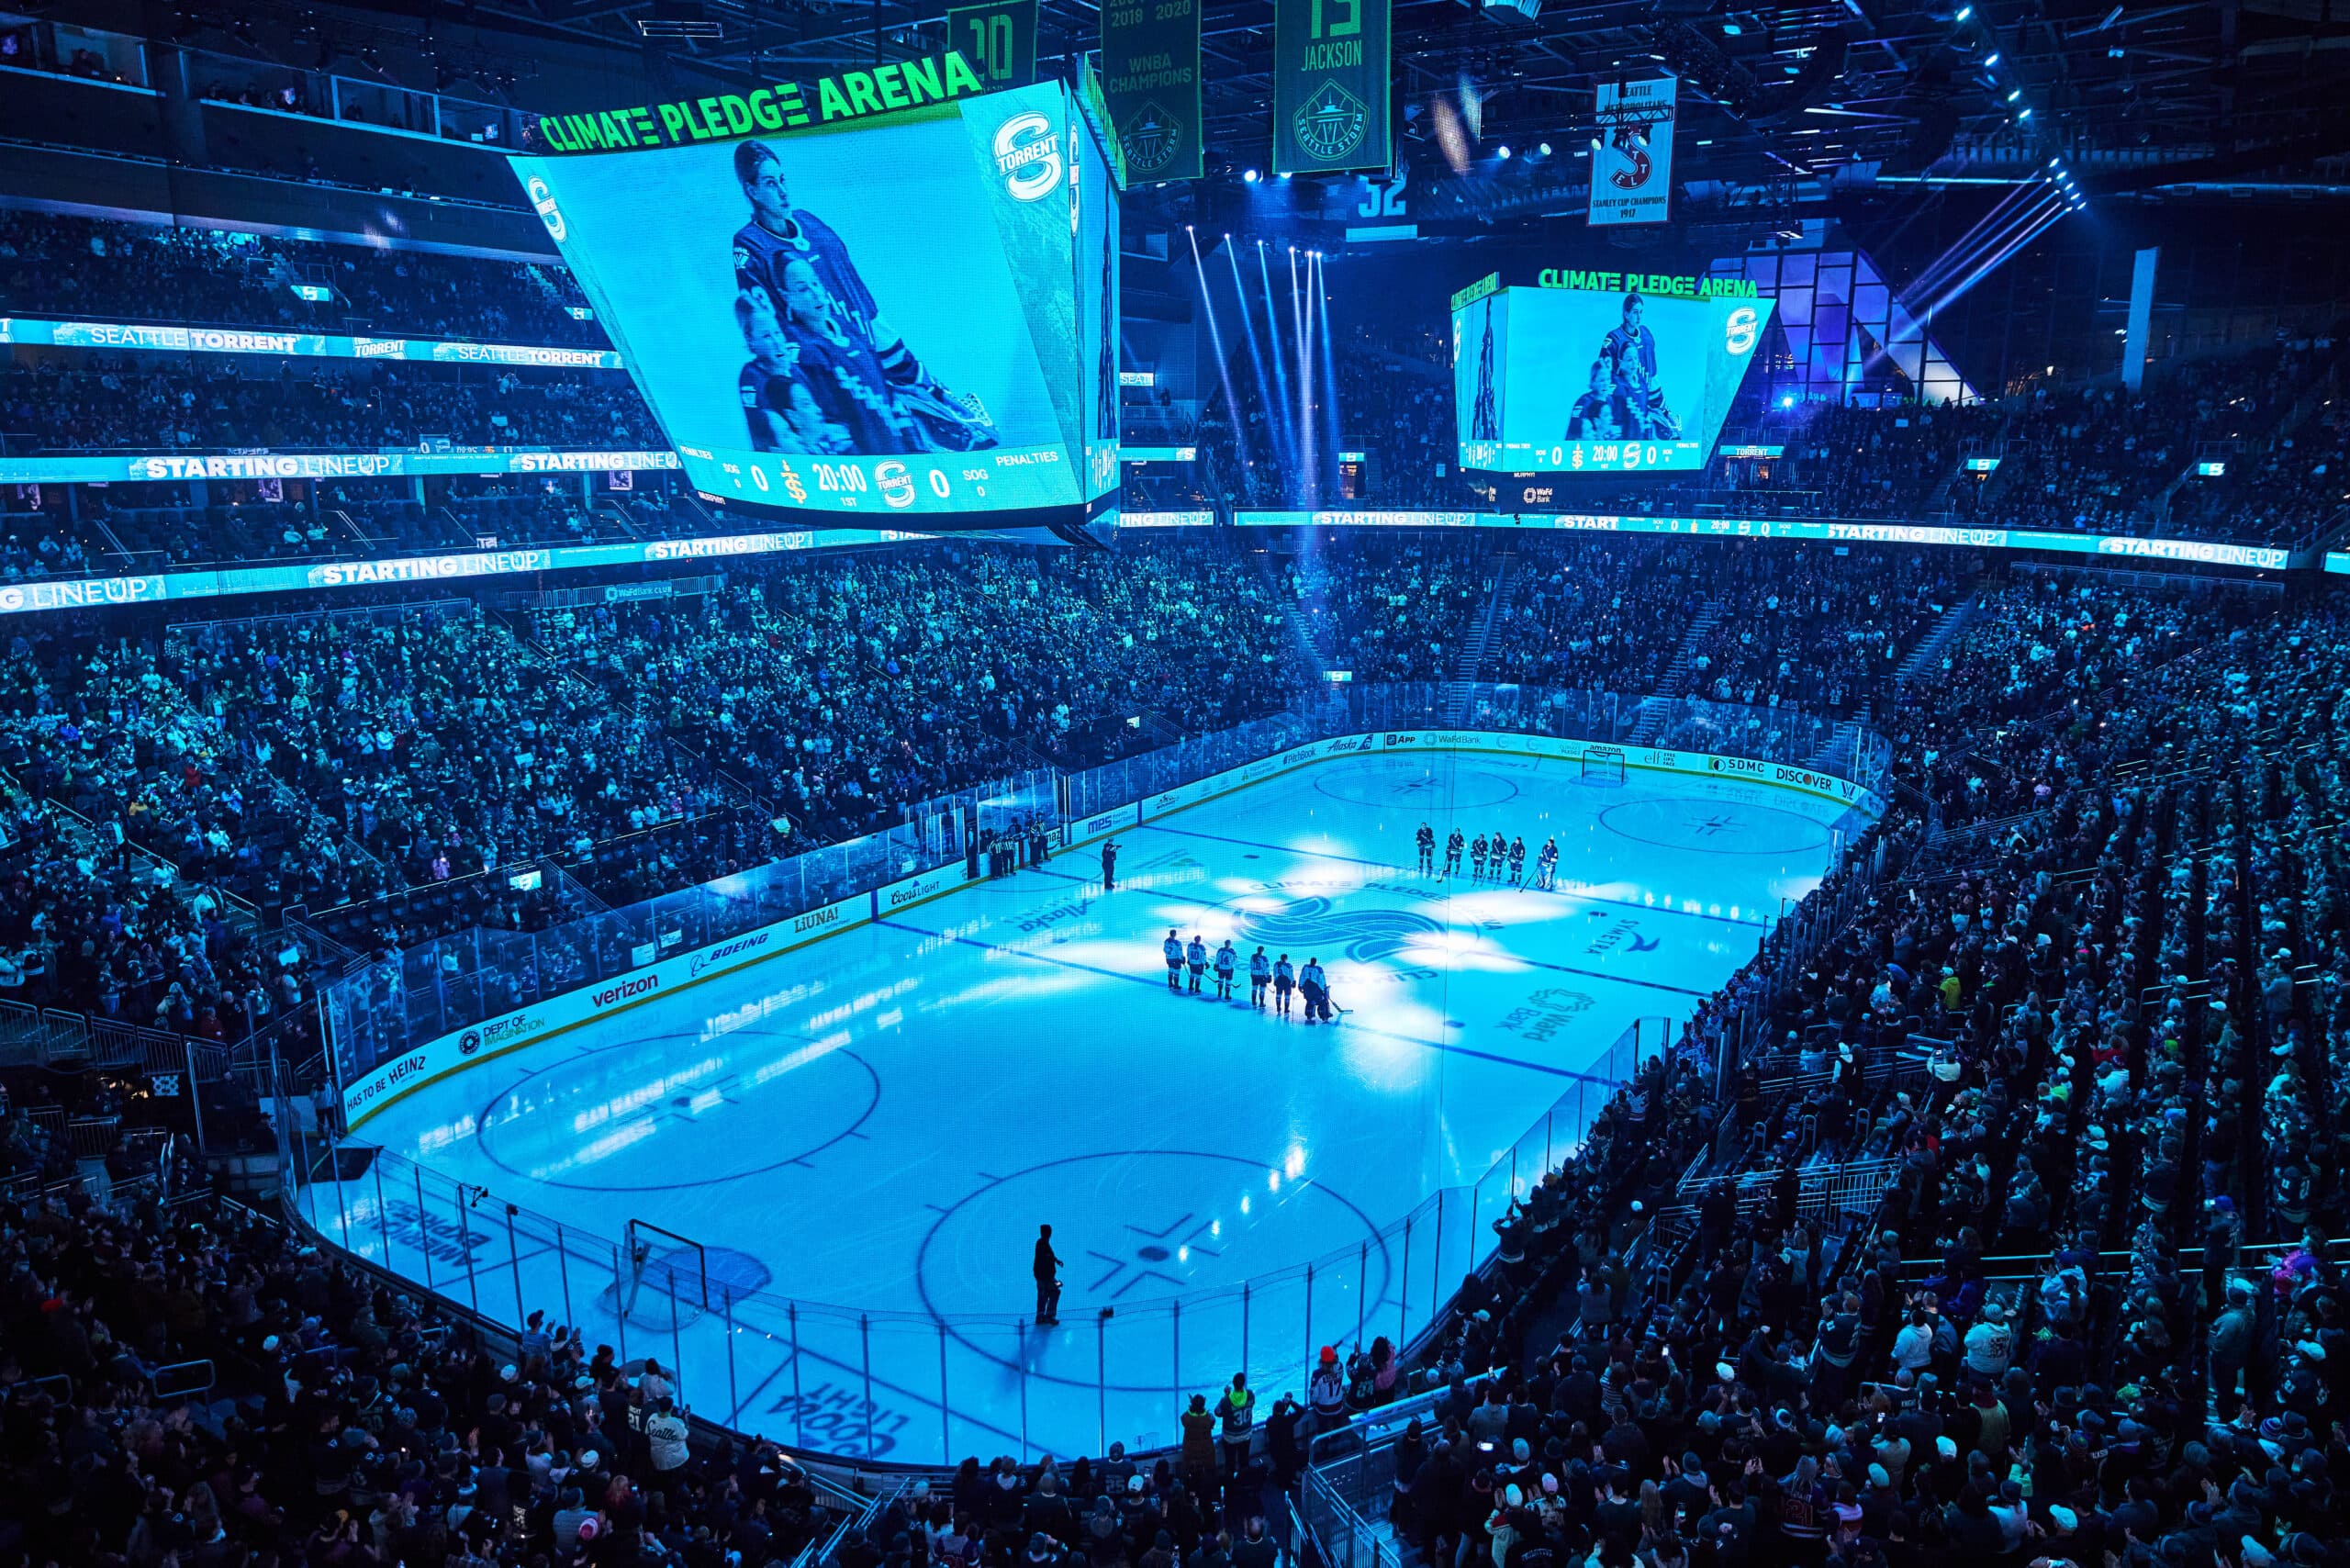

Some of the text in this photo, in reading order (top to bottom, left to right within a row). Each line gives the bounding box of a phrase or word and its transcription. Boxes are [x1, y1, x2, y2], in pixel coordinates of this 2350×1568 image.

[1129, 52, 1171, 73] WNBA
[1301, 39, 1361, 72] JACKSON
[1109, 67, 1192, 94] CHAMPIONS
[1624, 85, 1652, 97] EATTLE
[540, 50, 982, 151] CLIMATE PLEDGE ARENA
[1298, 112, 1364, 155] SEATTLE STORM
[998, 135, 1058, 173] TORRENT
[1539, 268, 1758, 298] CLIMATE PLEDGE ARENA
[1726, 321, 1758, 337] TORRENT
[92, 327, 297, 353] SEATTLE TORRENT
[354, 339, 406, 357] TORRENT
[459, 345, 602, 365] SEATTLE TORRENT
[520, 453, 682, 471] STARTING LINEU
[995, 451, 1058, 467] PENALTIES
[1551, 446, 1562, 465] 0
[1593, 445, 1617, 462] 20:00
[1647, 445, 1657, 465] 0
[1736, 448, 1768, 456] TORRENT
[146, 455, 389, 478] STARTING LINEUP
[962, 468, 989, 481] SOG
[750, 465, 769, 492] 0
[811, 463, 867, 492] 20:00
[877, 474, 912, 491] TORRENT
[928, 469, 950, 498] 0
[840, 497, 857, 507] 1ST
[976, 486, 986, 497] 0
[1158, 512, 1208, 525] LINEUP
[1321, 512, 1406, 525] STARTING
[1412, 512, 1467, 525] LINEUP
[1563, 516, 1618, 530] START
[1711, 520, 1729, 530] 20:00
[1828, 523, 1997, 544] STARTING LINEUP
[655, 537, 747, 559] STARTING
[750, 533, 805, 552] LINEUP
[2109, 538, 2284, 566] STARTING LINEUP
[323, 552, 539, 585] STARTING LINEUP
[33, 579, 147, 608] LINEUP
[654, 585, 672, 595] CLUB
[1327, 738, 1357, 753] Alaska
[1589, 744, 1622, 754] amazon
[1728, 758, 1765, 773] SDMC
[1776, 767, 1832, 791] DISCOVER
[890, 880, 940, 905] Coors LIGHT
[710, 933, 769, 961] BOEING
[592, 973, 658, 1008] verizon
[483, 1014, 526, 1037] DEPT OF
[485, 1017, 545, 1047] IMAGINATION
[347, 1094, 363, 1113] HAS
[363, 1086, 375, 1102] TO
[375, 1077, 386, 1092] BE
[388, 1056, 426, 1085] HEINZ
[647, 1419, 677, 1441] Seattle
